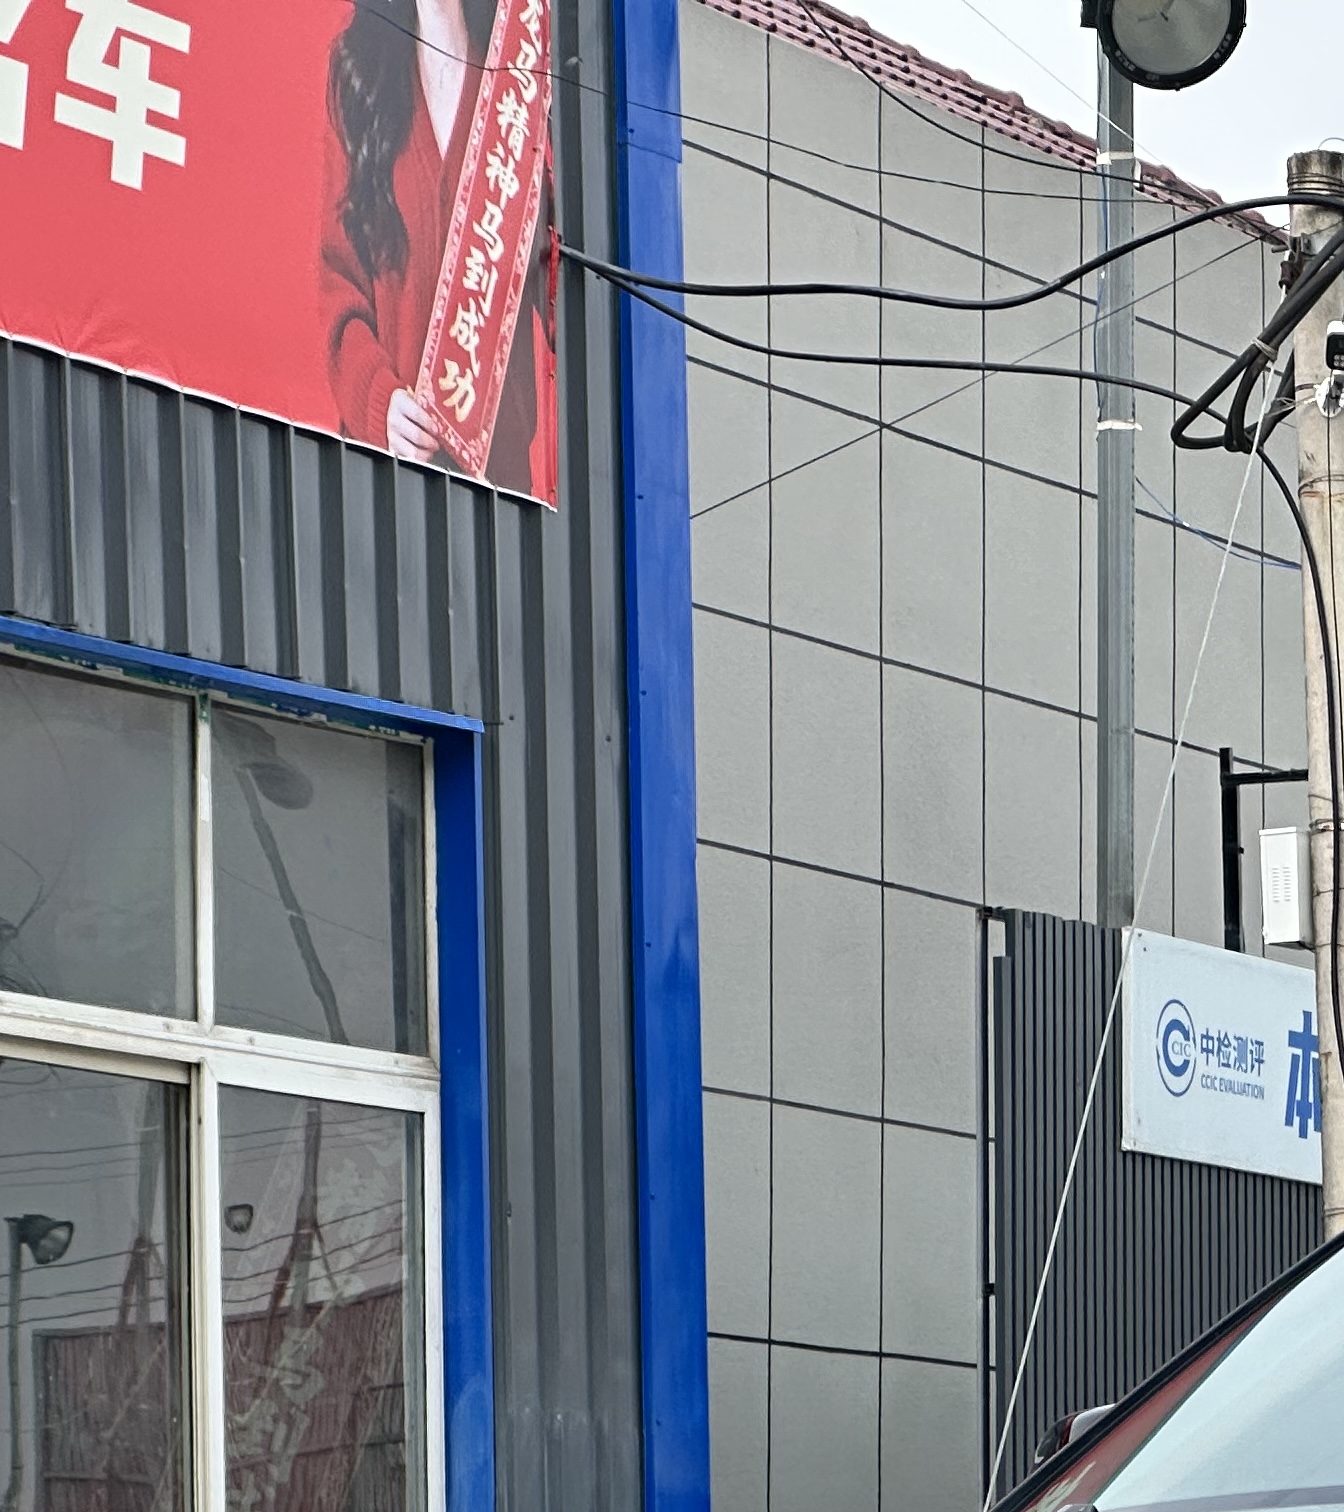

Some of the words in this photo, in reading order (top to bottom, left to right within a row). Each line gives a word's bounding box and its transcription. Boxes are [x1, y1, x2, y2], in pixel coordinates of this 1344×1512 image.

[0, 0, 191, 191] 车
[1200, 1027, 1266, 1078] 中检测评
[1200, 1073, 1218, 1092] CCIC
[1219, 1079, 1265, 1100] EVALUATION
